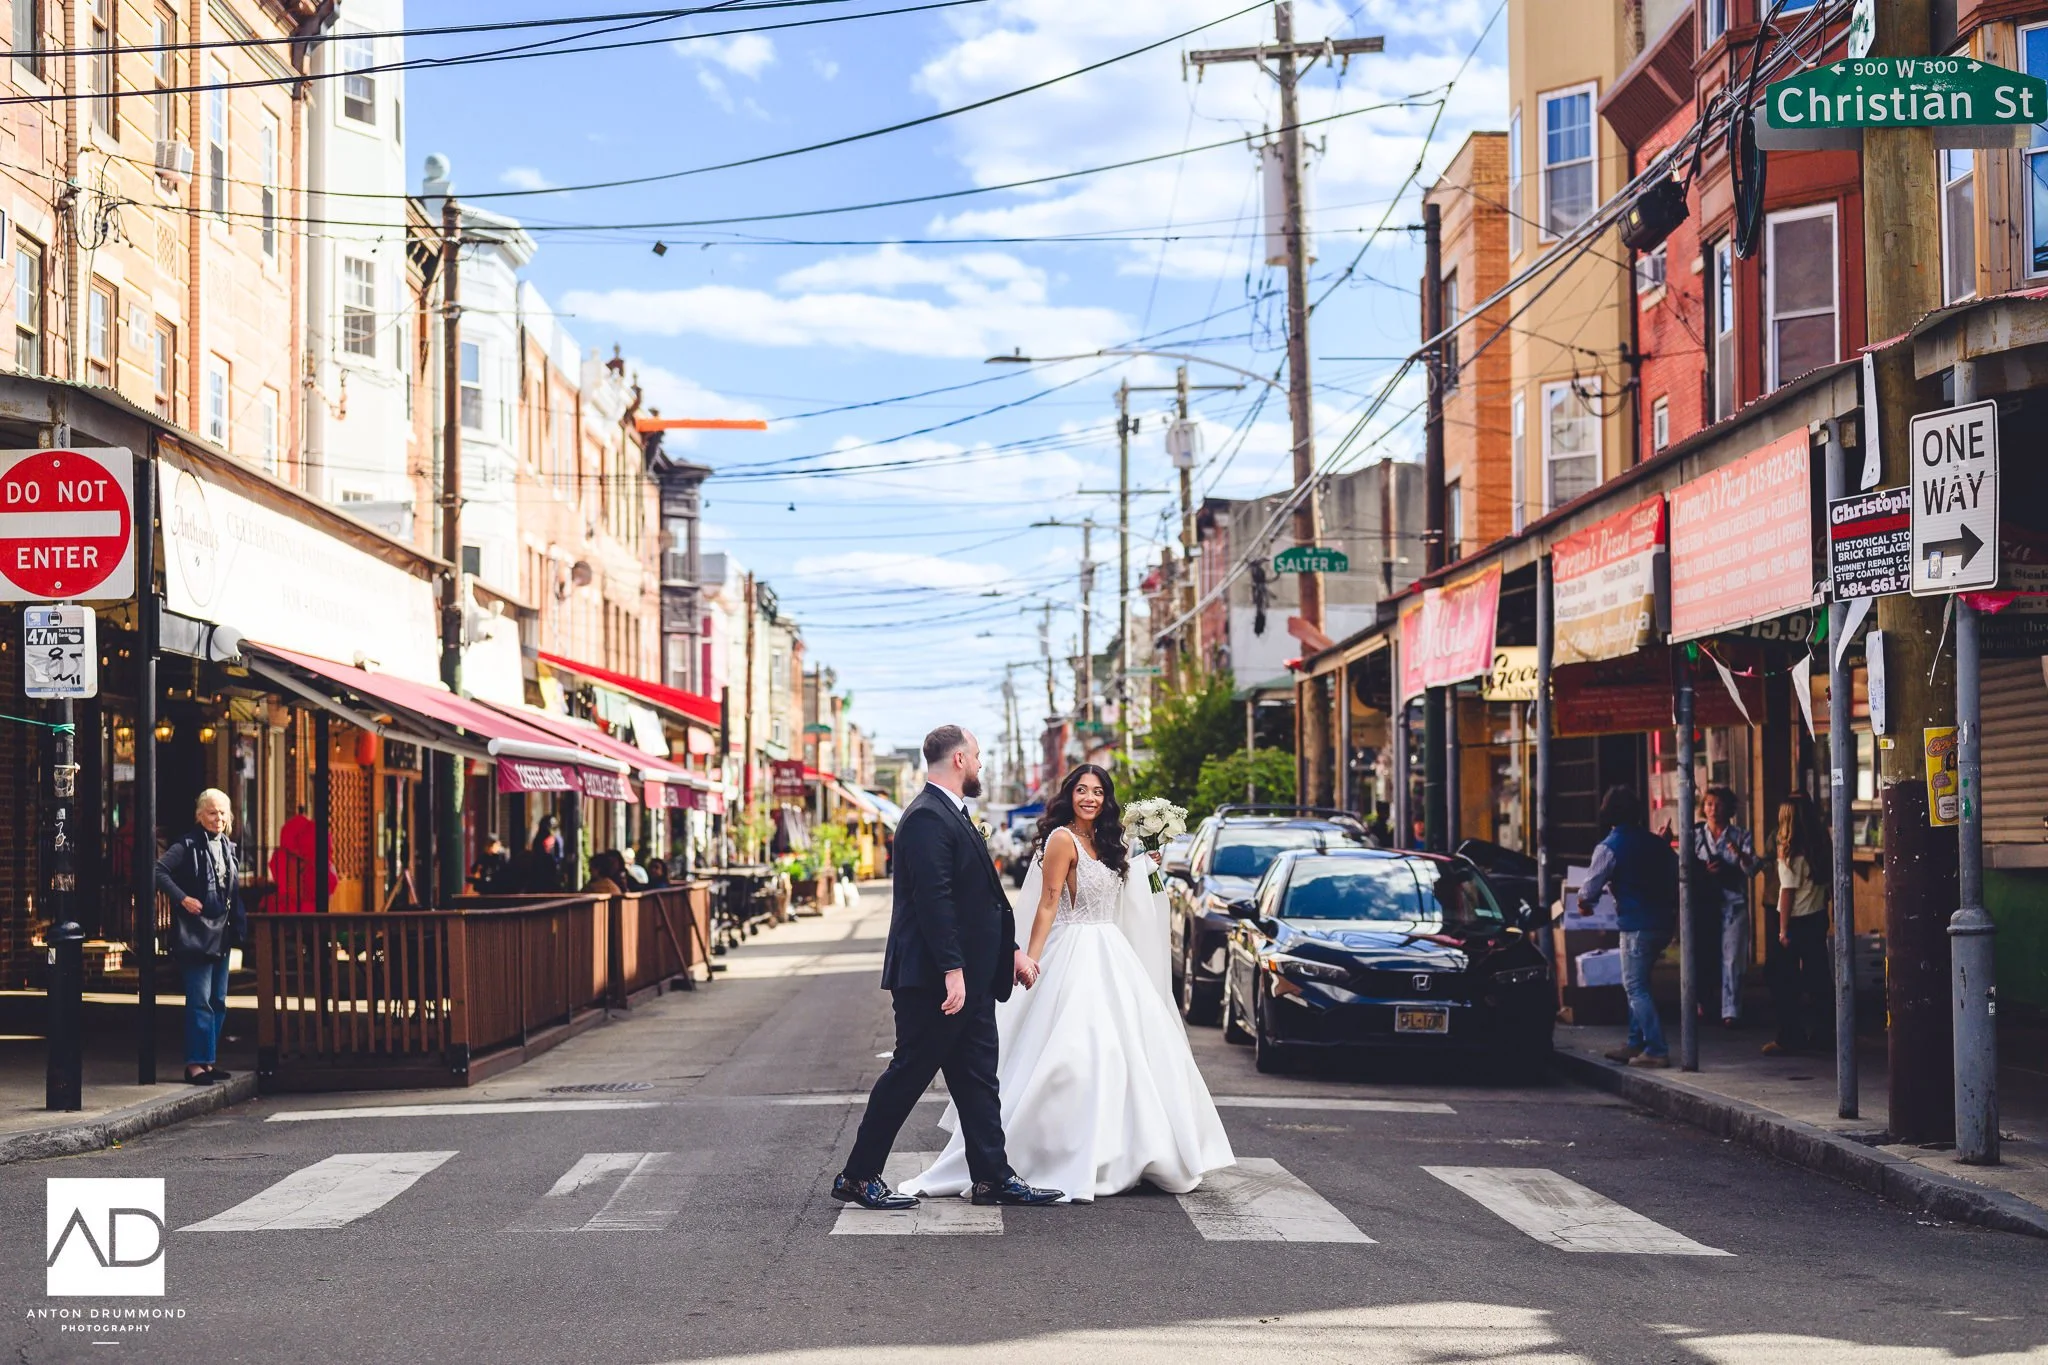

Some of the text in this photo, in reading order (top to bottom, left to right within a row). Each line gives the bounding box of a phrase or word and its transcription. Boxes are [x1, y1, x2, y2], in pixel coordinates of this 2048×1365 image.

[1854, 60, 1958, 78] 900 W 800
[1777, 85, 2033, 122] Christian St
[1922, 420, 1985, 467] ONE
[7, 480, 108, 504] DO NOT
[1922, 470, 1985, 516] WAY
[1835, 532, 1910, 552] HISTORICAL STO
[17, 546, 98, 569] ENTER
[1276, 557, 1329, 572] SALTER
[1834, 561, 1866, 574] CHIMNEY
[1868, 557, 1894, 568] REPAIR
[1896, 555, 1902, 564] &
[1838, 549, 1864, 562] BRICK
[1836, 572, 1855, 582] STEP
[27, 628, 57, 645] 47M
[515, 763, 548, 789] COFFEE
